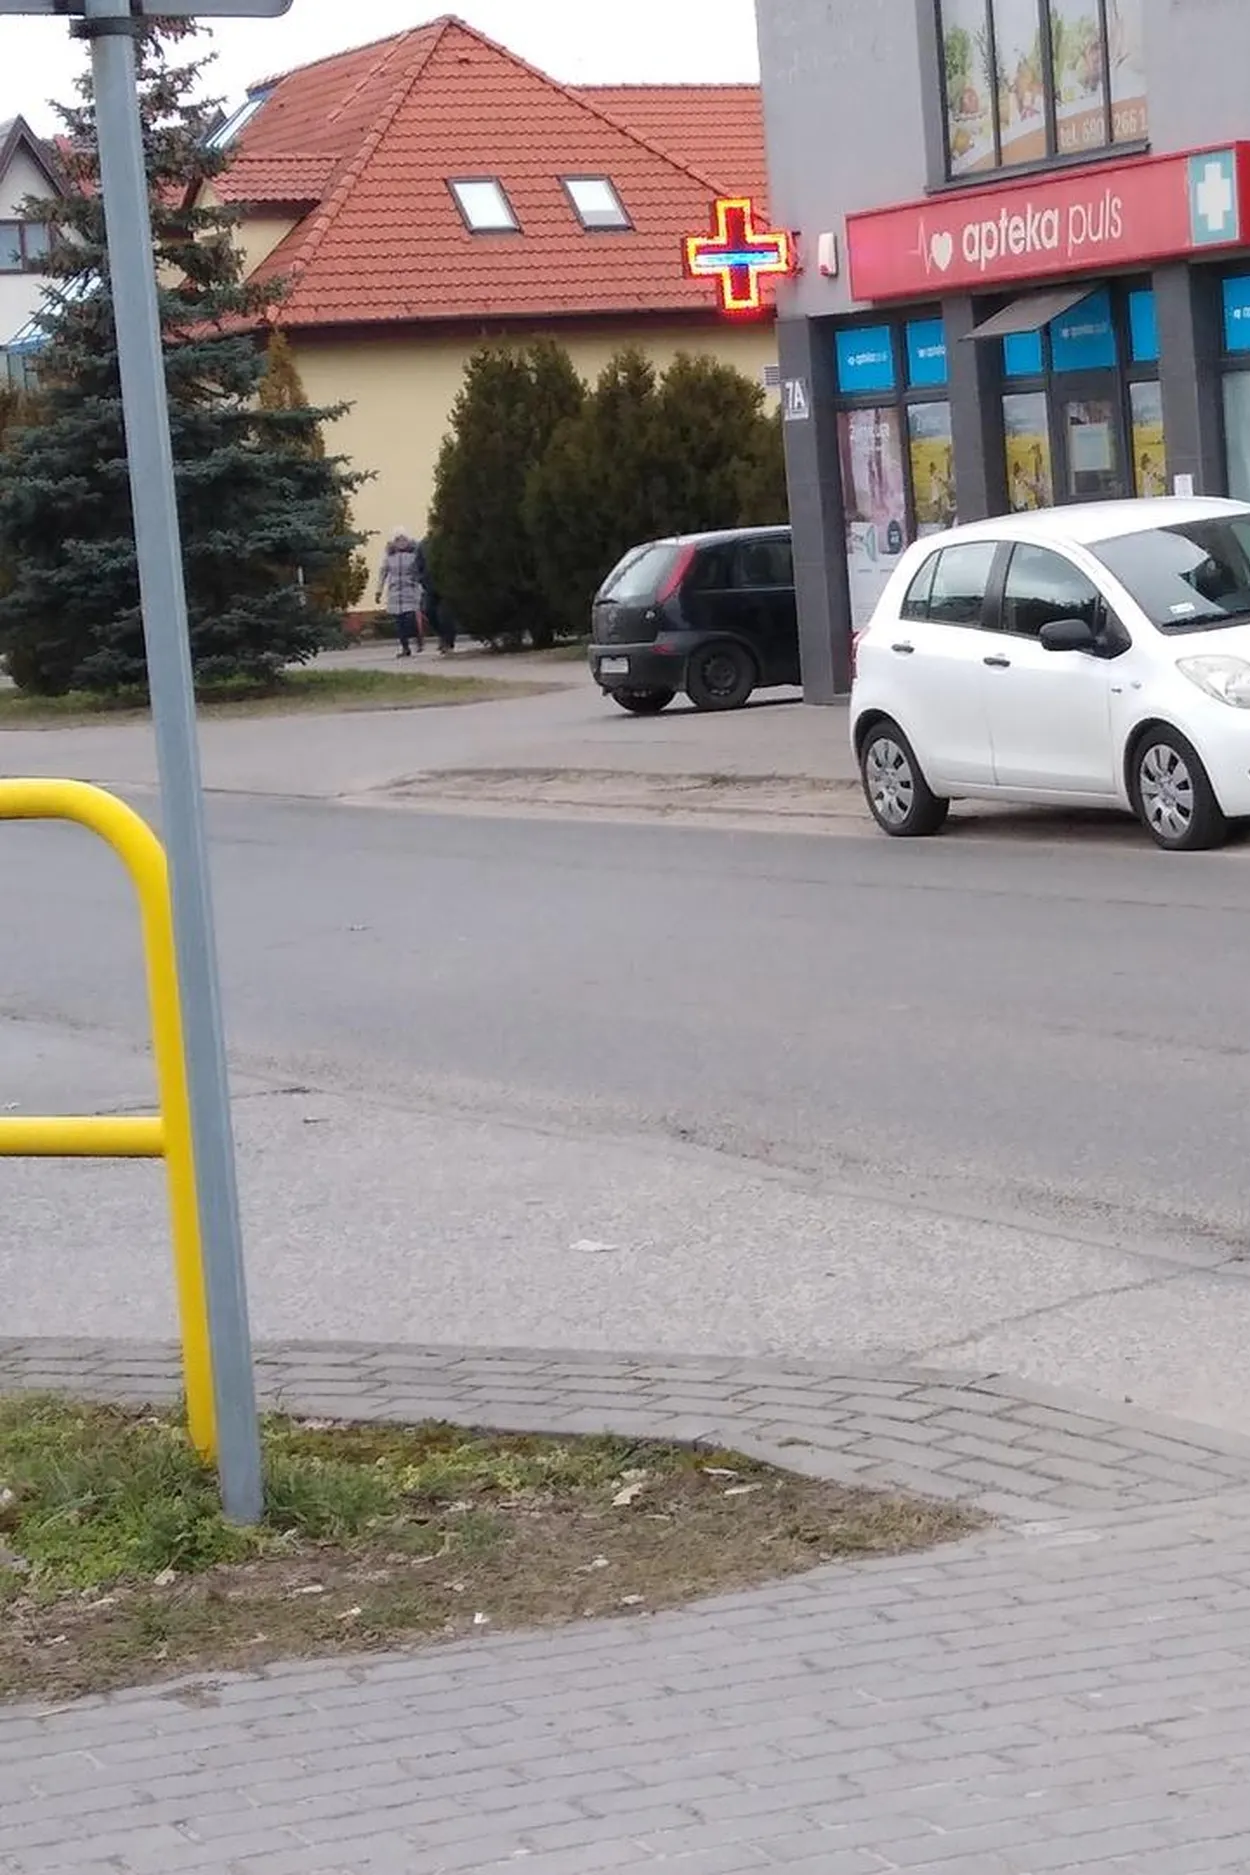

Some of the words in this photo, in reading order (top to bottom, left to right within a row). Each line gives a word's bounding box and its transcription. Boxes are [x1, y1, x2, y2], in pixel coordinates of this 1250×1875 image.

[962, 203, 1059, 271] apteka
[1067, 188, 1122, 257] puls
[785, 381, 805, 409] 7A
